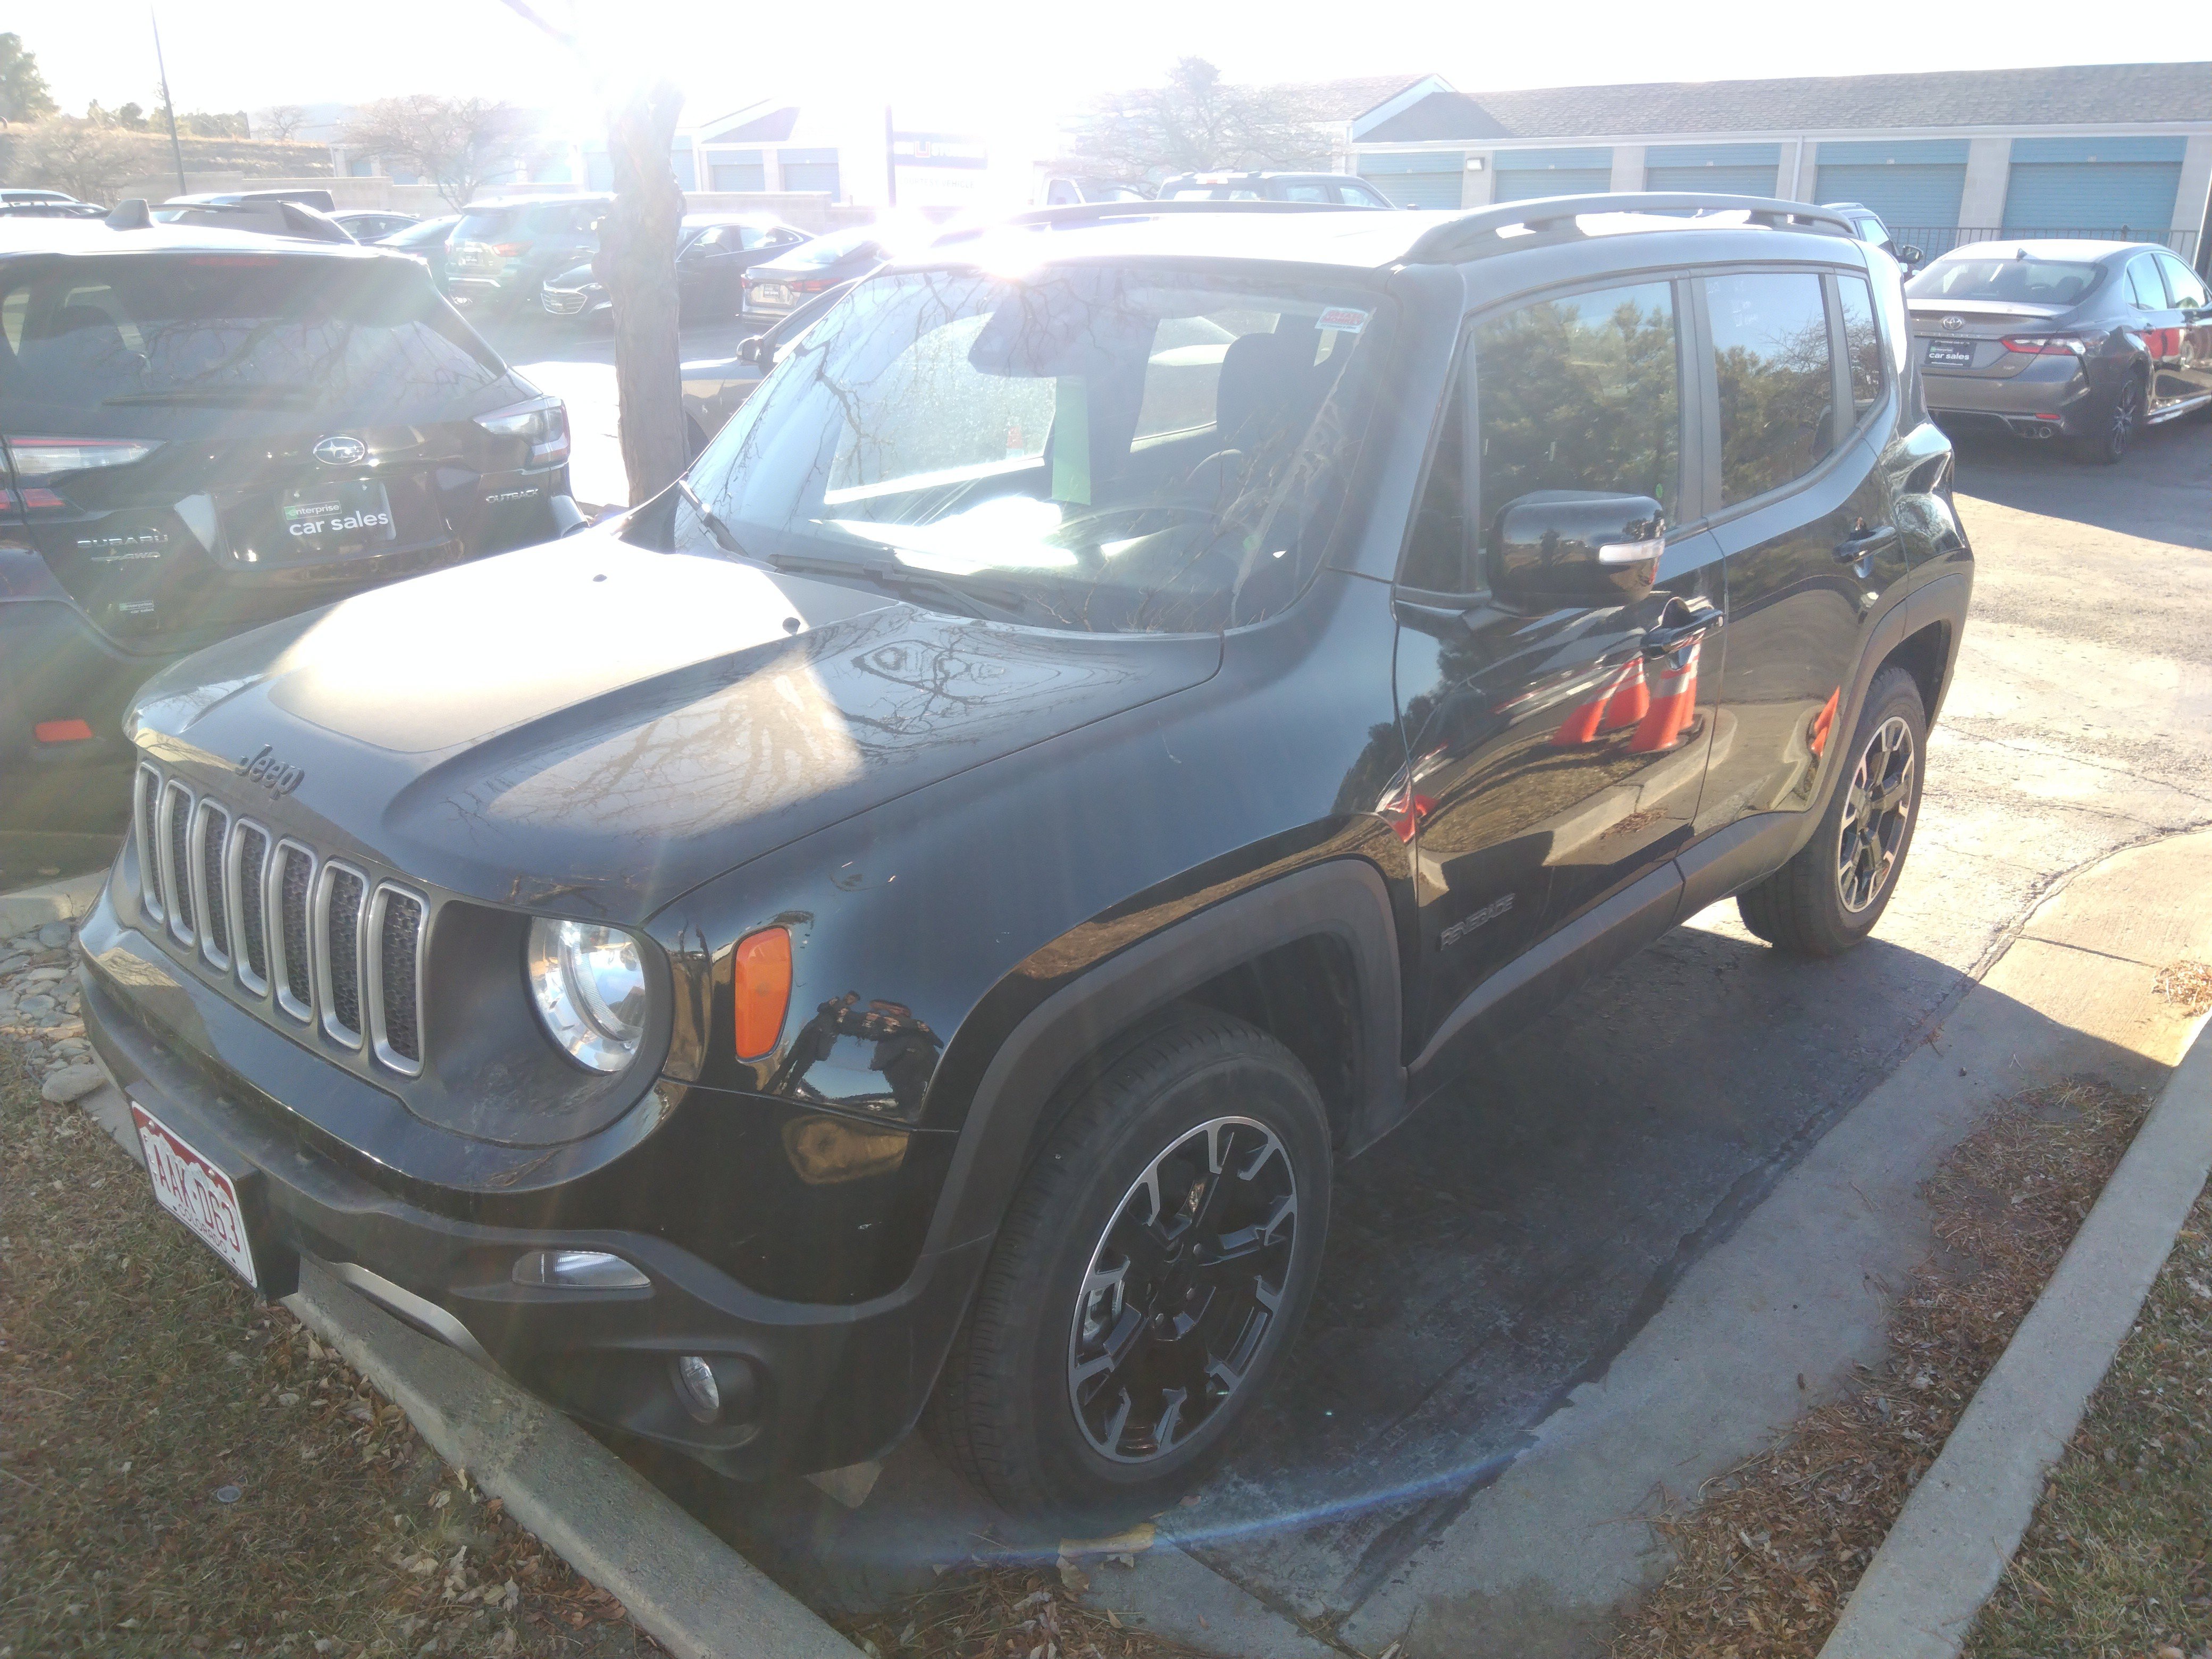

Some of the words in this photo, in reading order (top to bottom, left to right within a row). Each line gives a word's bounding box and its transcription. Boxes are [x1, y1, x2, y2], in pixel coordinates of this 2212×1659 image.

[942, 178, 975, 189] VEHICLE
[1946, 351, 1970, 360] sales
[485, 489, 539, 503] OUTBACK
[286, 504, 340, 517] enterprise
[289, 520, 325, 536] car
[331, 510, 389, 531] sales
[77, 534, 168, 548] SUBARU
[235, 744, 305, 800] Jeep
[178, 1203, 227, 1253] COLORADO
